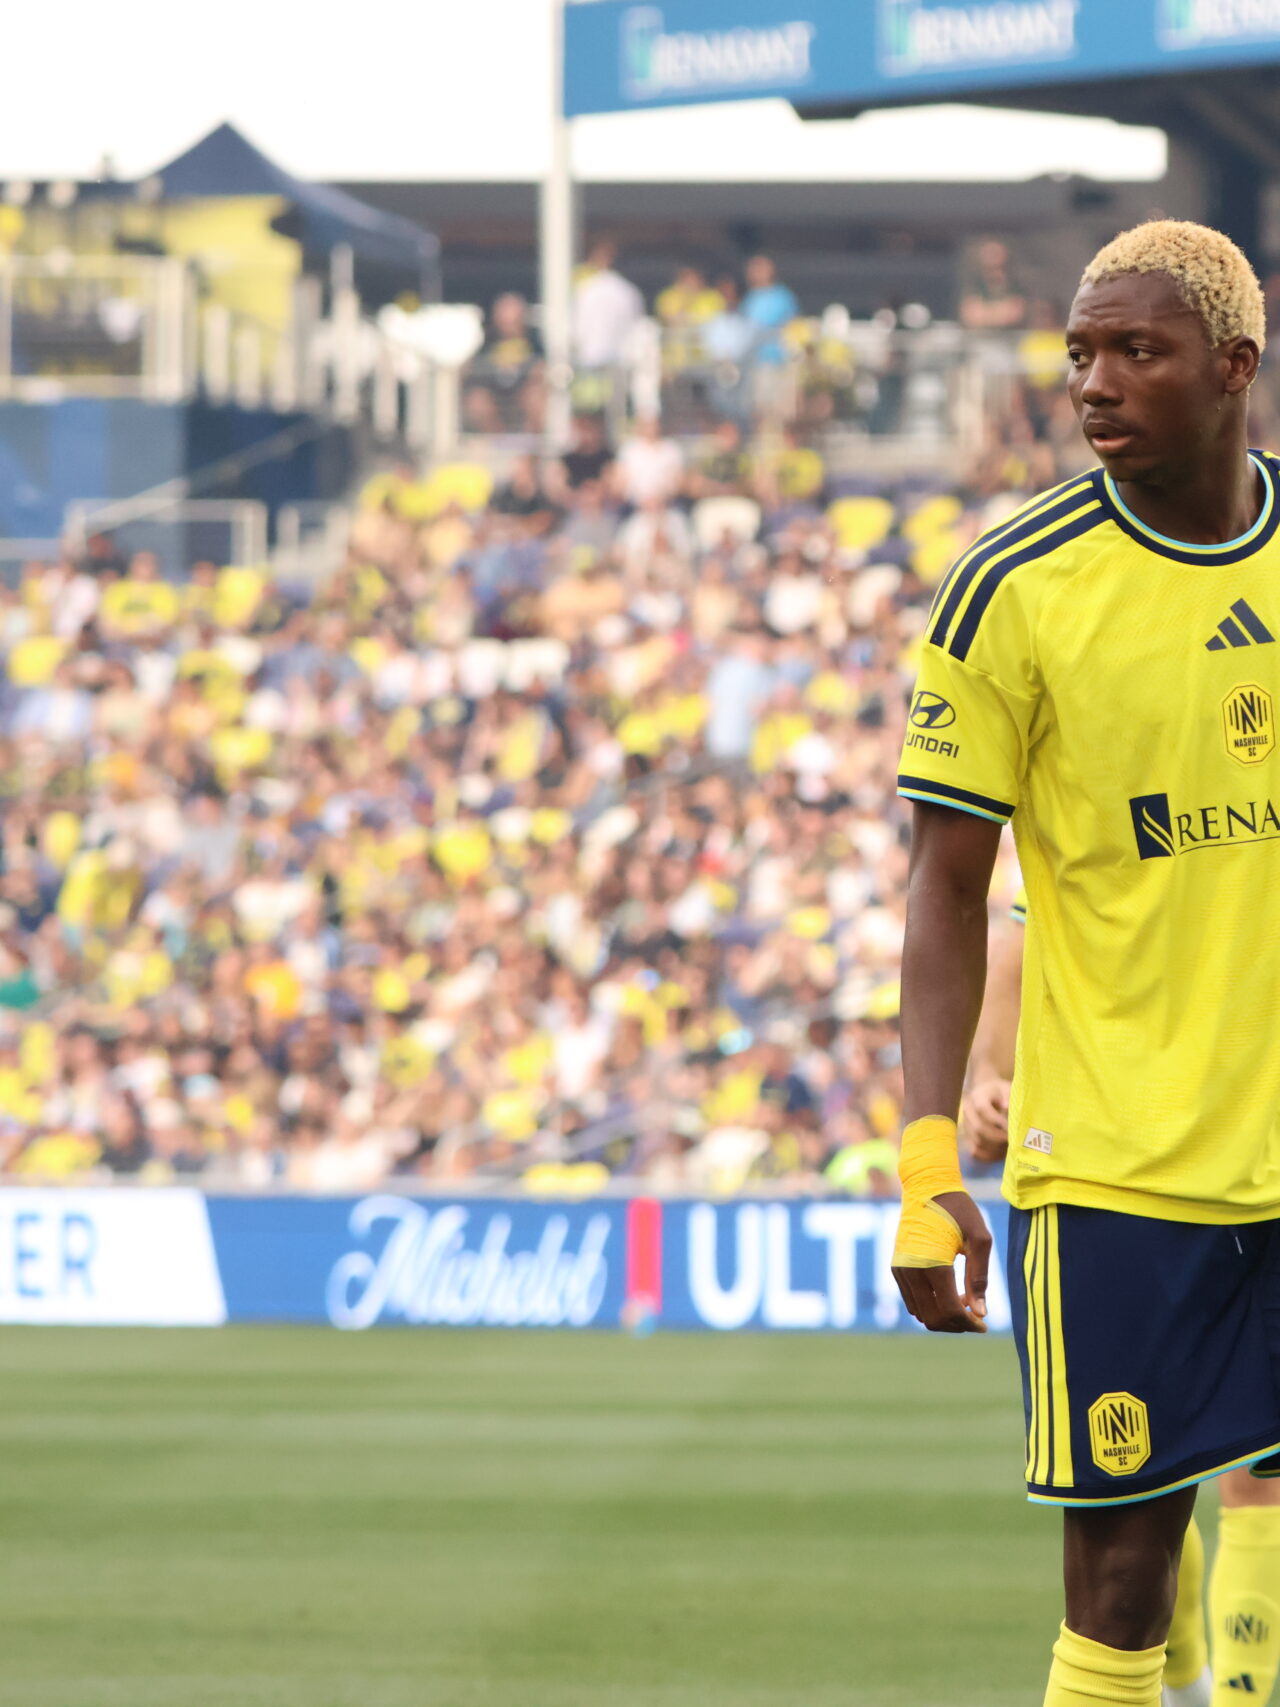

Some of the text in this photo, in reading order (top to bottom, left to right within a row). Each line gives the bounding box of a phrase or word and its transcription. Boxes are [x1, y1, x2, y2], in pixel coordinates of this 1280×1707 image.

[1233, 734, 1268, 748] NASHVILLE
[1248, 747, 1257, 757] SC
[0, 1208, 97, 1298] ER
[1103, 1444, 1141, 1457] NASHVILLE
[1118, 1456, 1128, 1466] SC
